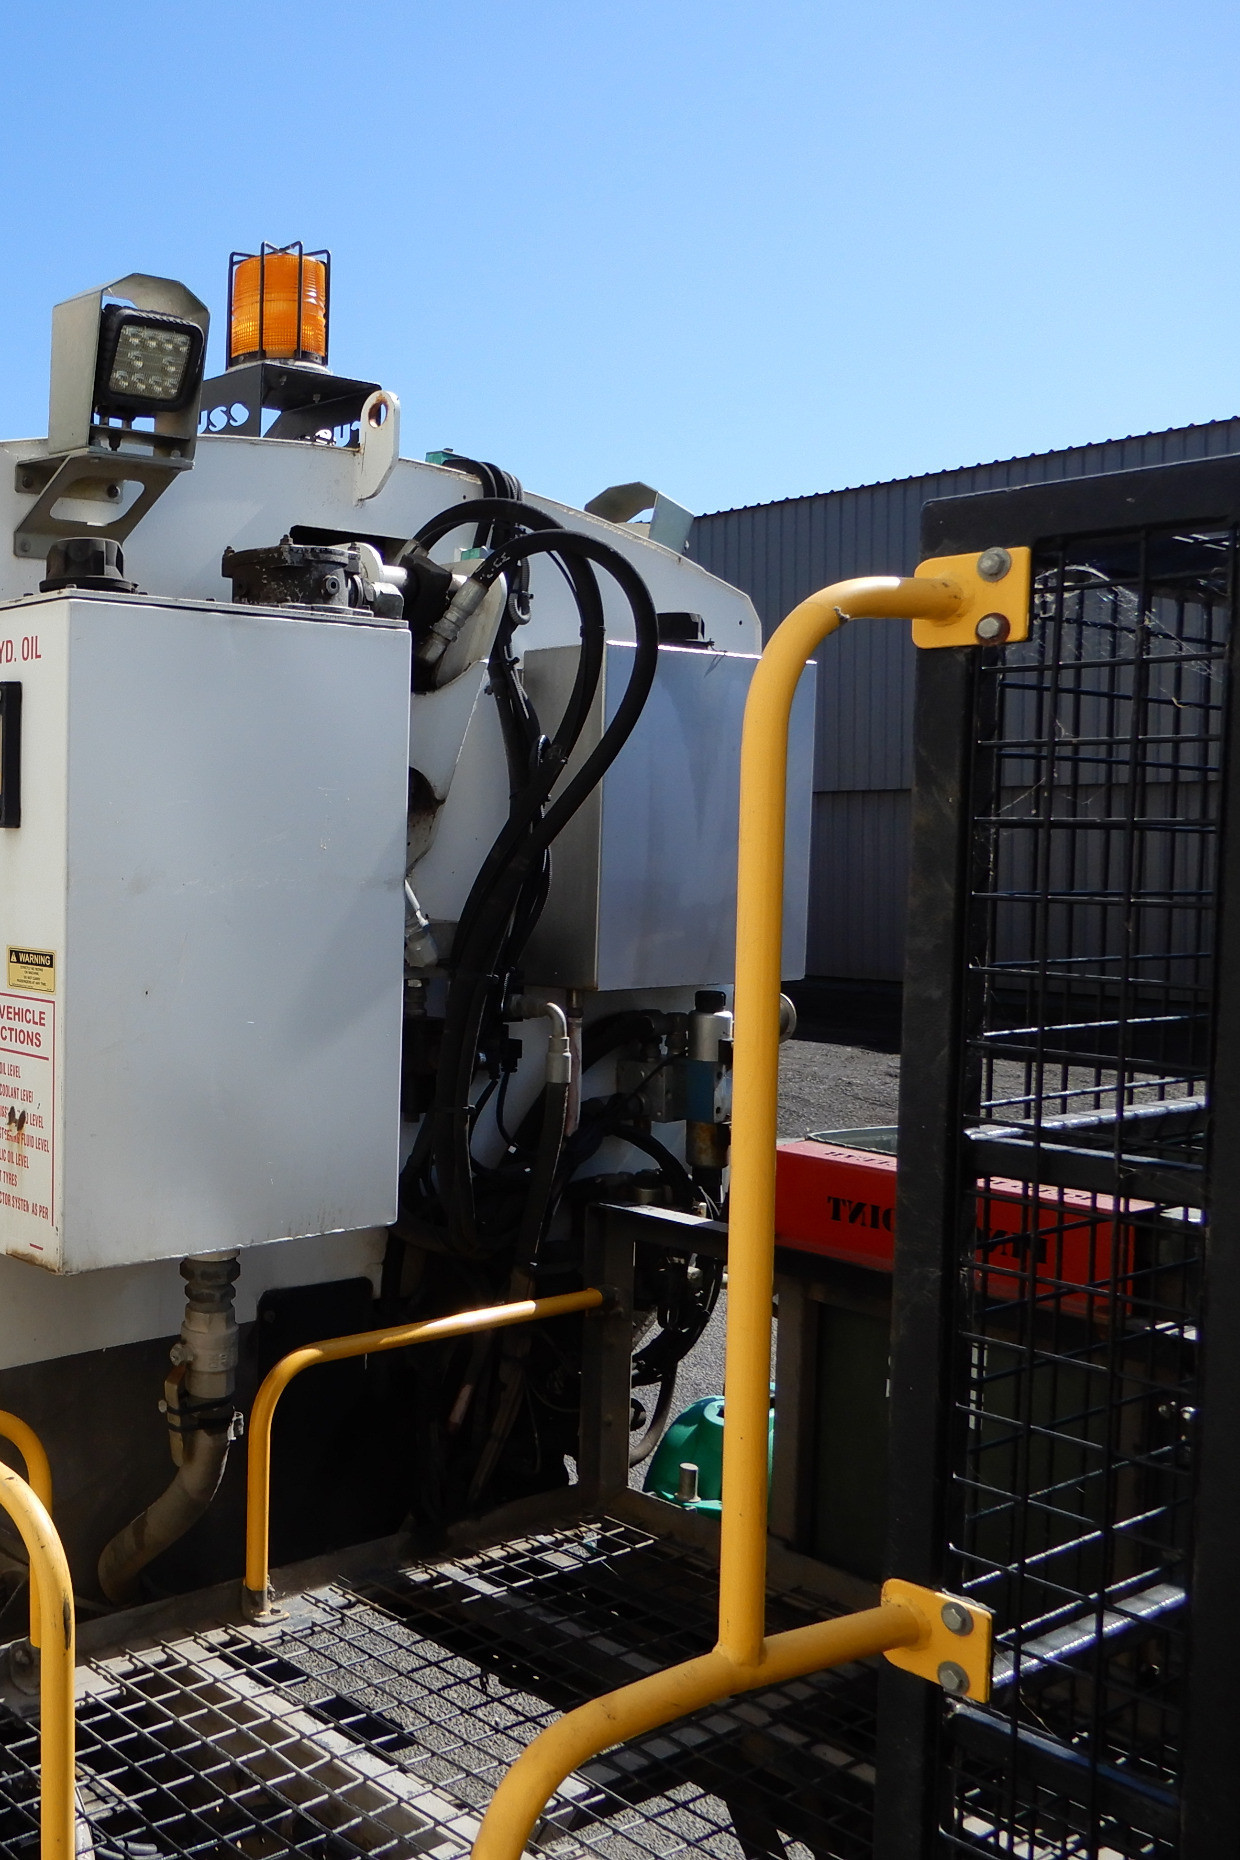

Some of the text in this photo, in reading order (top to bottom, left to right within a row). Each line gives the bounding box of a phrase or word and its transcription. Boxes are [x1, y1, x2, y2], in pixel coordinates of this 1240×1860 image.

[22, 636, 42, 661] OIL
[19, 952, 51, 966] WARNING
[0, 1004, 46, 1027] VEHICLE
[7, 1063, 21, 1078] LEVEL
[30, 1112, 44, 1129] LEVEL
[35, 1137, 49, 1153] LEVEL
[15, 1152, 29, 1169] LEVEL
[3, 1170, 17, 1187] TYRES
[31, 1202, 38, 1216] AS
[38, 1204, 49, 1220] PER
